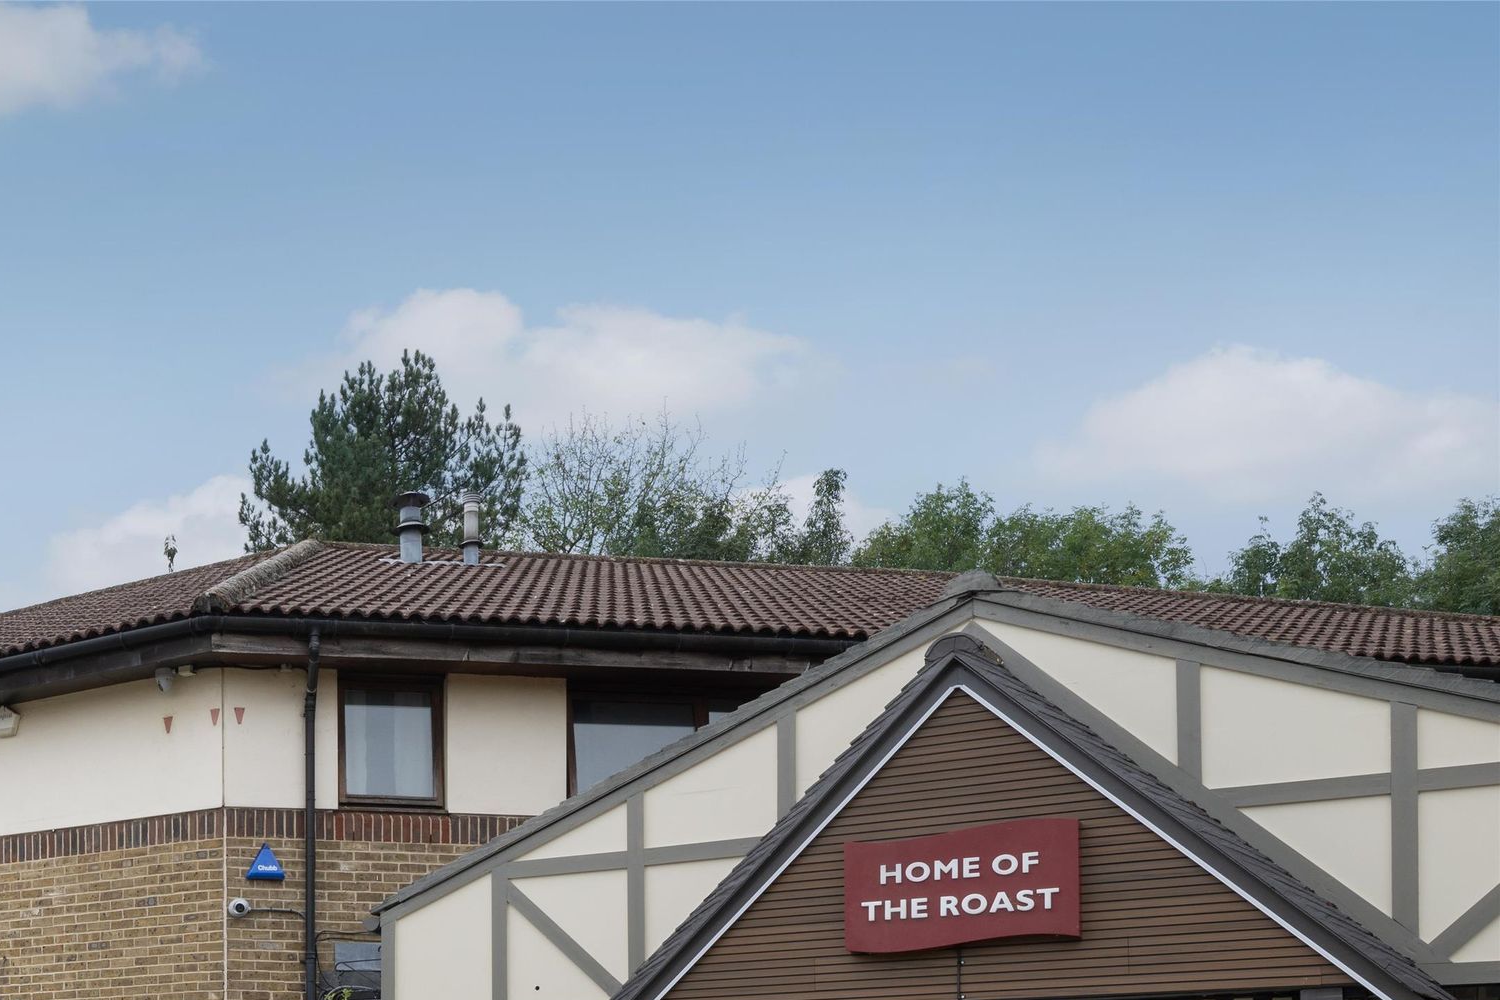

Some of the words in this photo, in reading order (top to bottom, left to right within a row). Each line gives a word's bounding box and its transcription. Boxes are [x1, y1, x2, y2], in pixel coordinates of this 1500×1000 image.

[879, 856, 981, 885] HOME
[991, 851, 1040, 876] OF
[860, 897, 929, 922] THE
[939, 887, 1060, 917] ROAST
